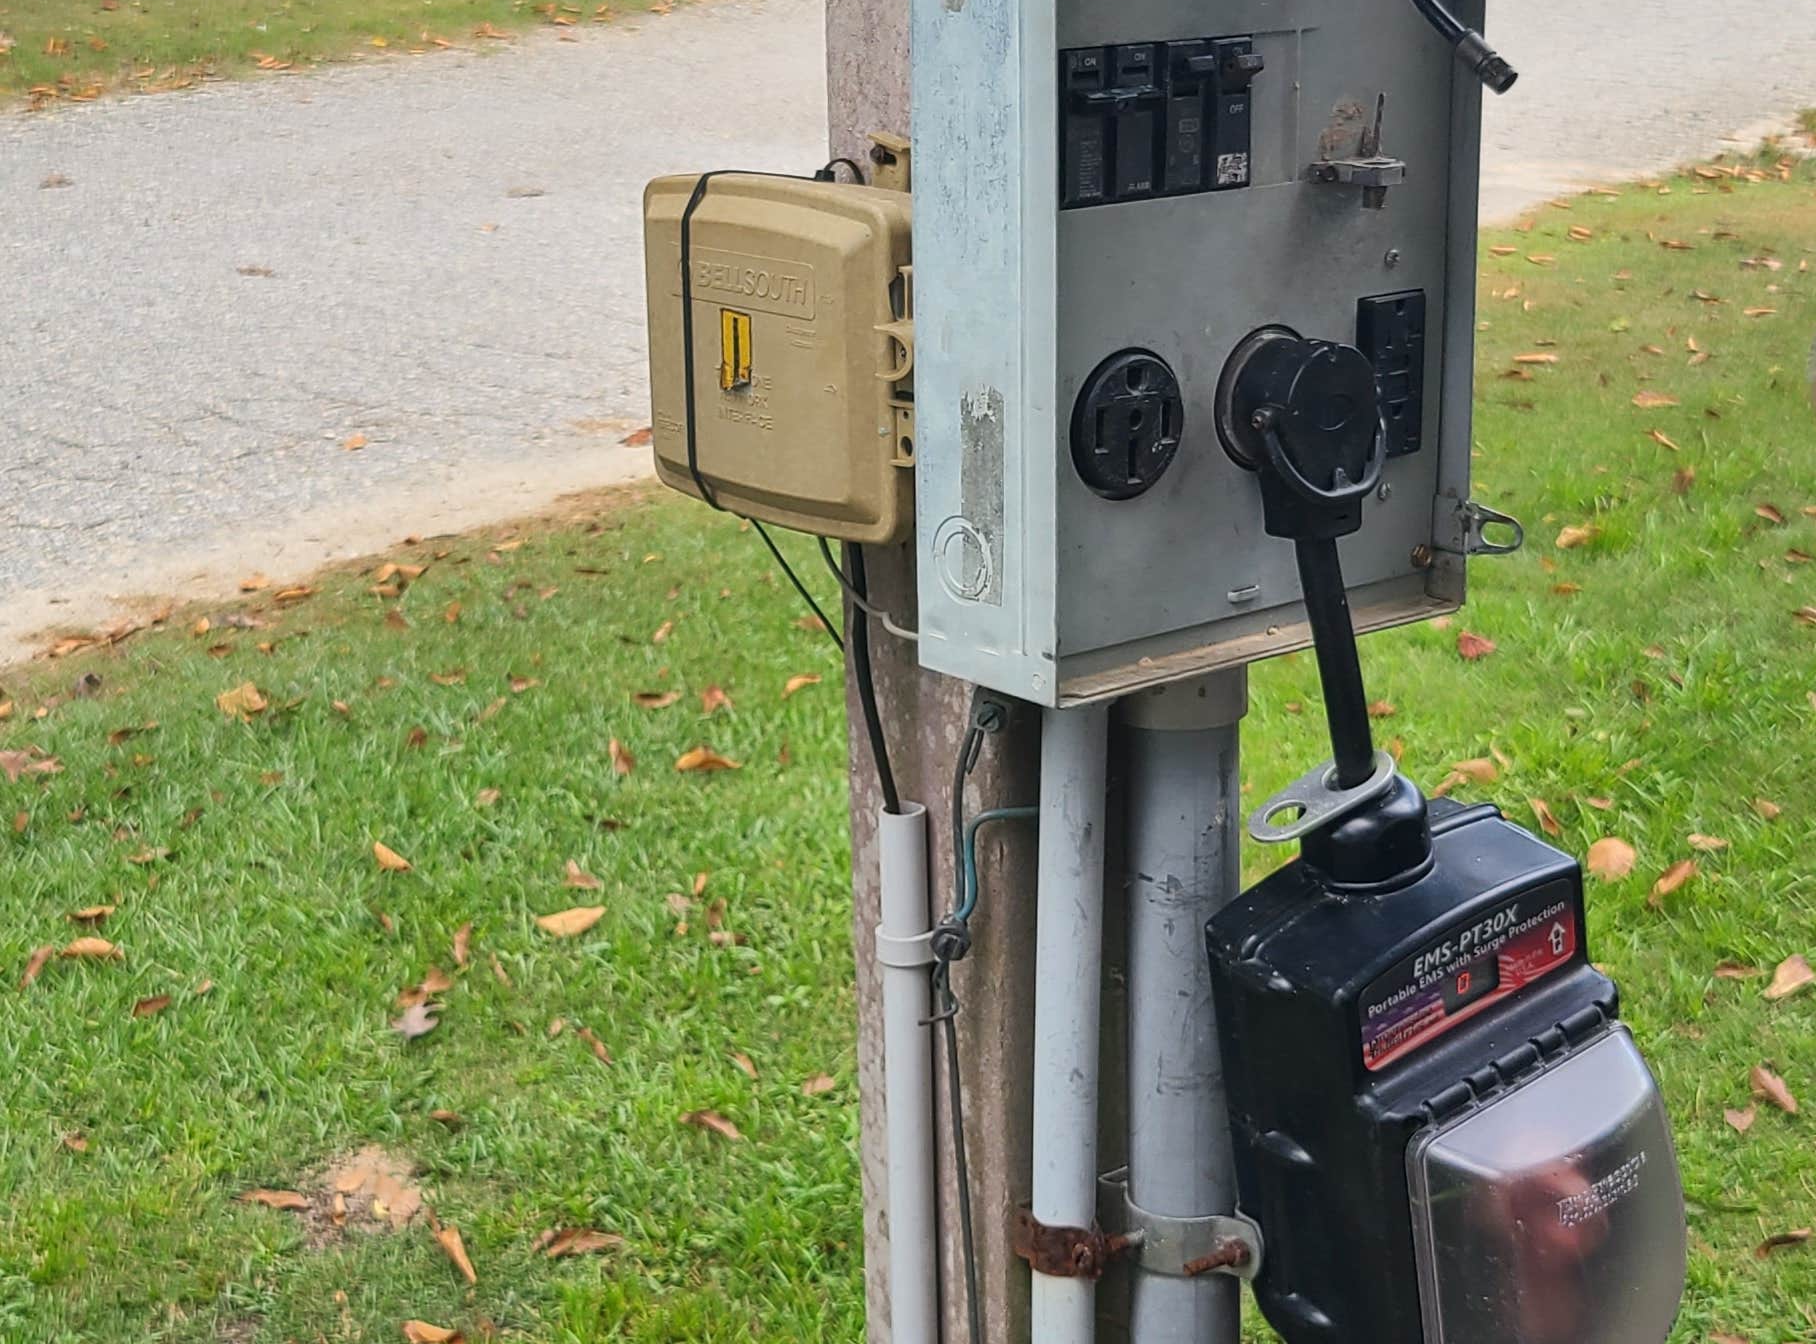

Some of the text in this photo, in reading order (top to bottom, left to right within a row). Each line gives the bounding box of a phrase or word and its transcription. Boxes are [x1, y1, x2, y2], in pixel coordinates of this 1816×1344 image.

[1083, 55, 1098, 67] ON
[1229, 103, 1245, 114] OFF
[695, 259, 809, 306] BELLSOUTH
[1367, 900, 1565, 1019] Portable EMS with Surge Protection
[1412, 903, 1520, 979] EMS-PT30X
